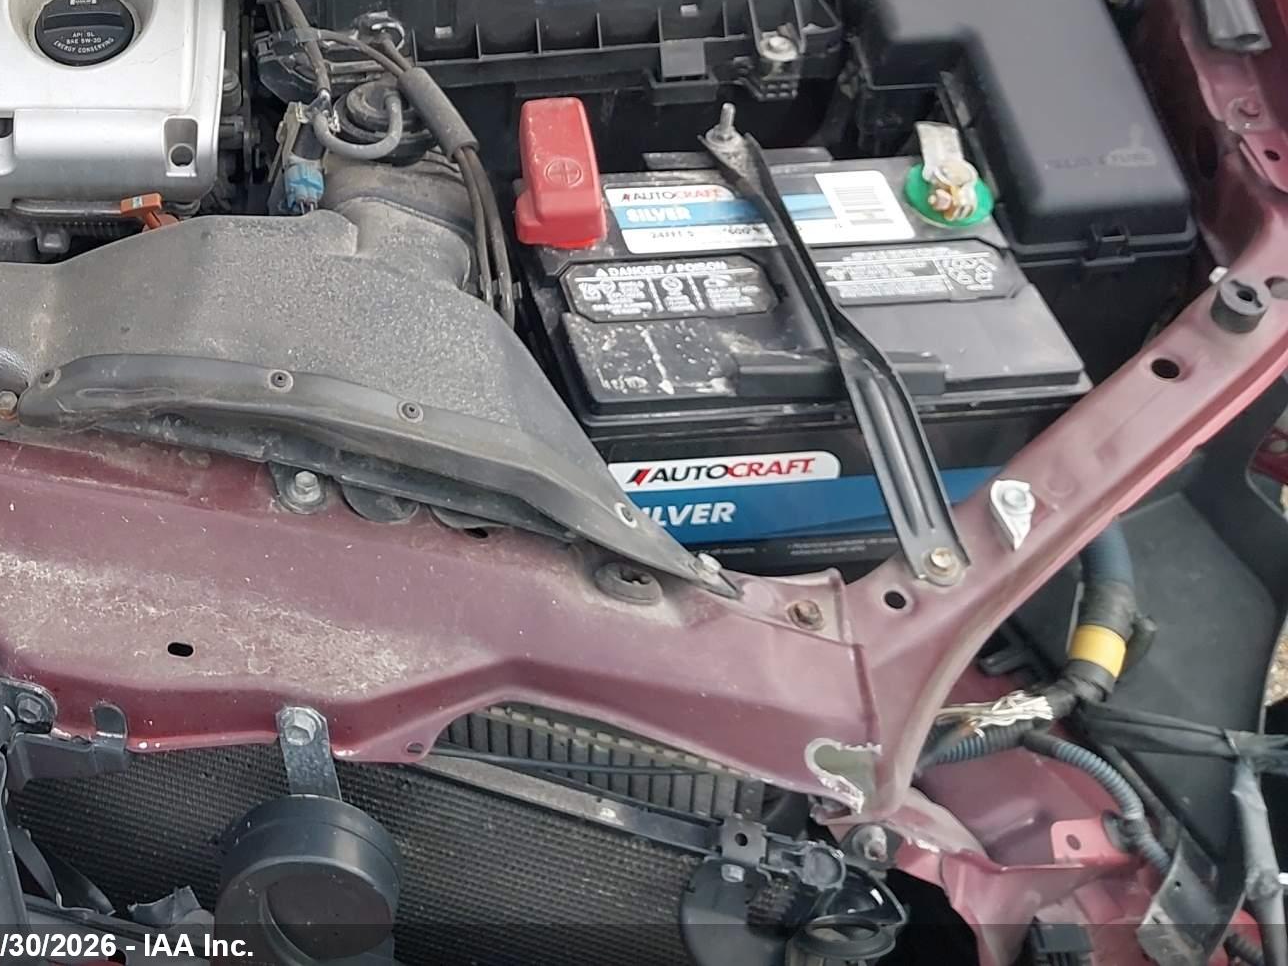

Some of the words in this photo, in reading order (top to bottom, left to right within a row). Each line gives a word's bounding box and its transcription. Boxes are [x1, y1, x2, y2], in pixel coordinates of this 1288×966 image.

[53, 40, 76, 52] ENERGY
[77, 37, 115, 53] CONSERVING
[625, 206, 692, 223] SILVER
[648, 457, 816, 483] AUTOCRAFT
